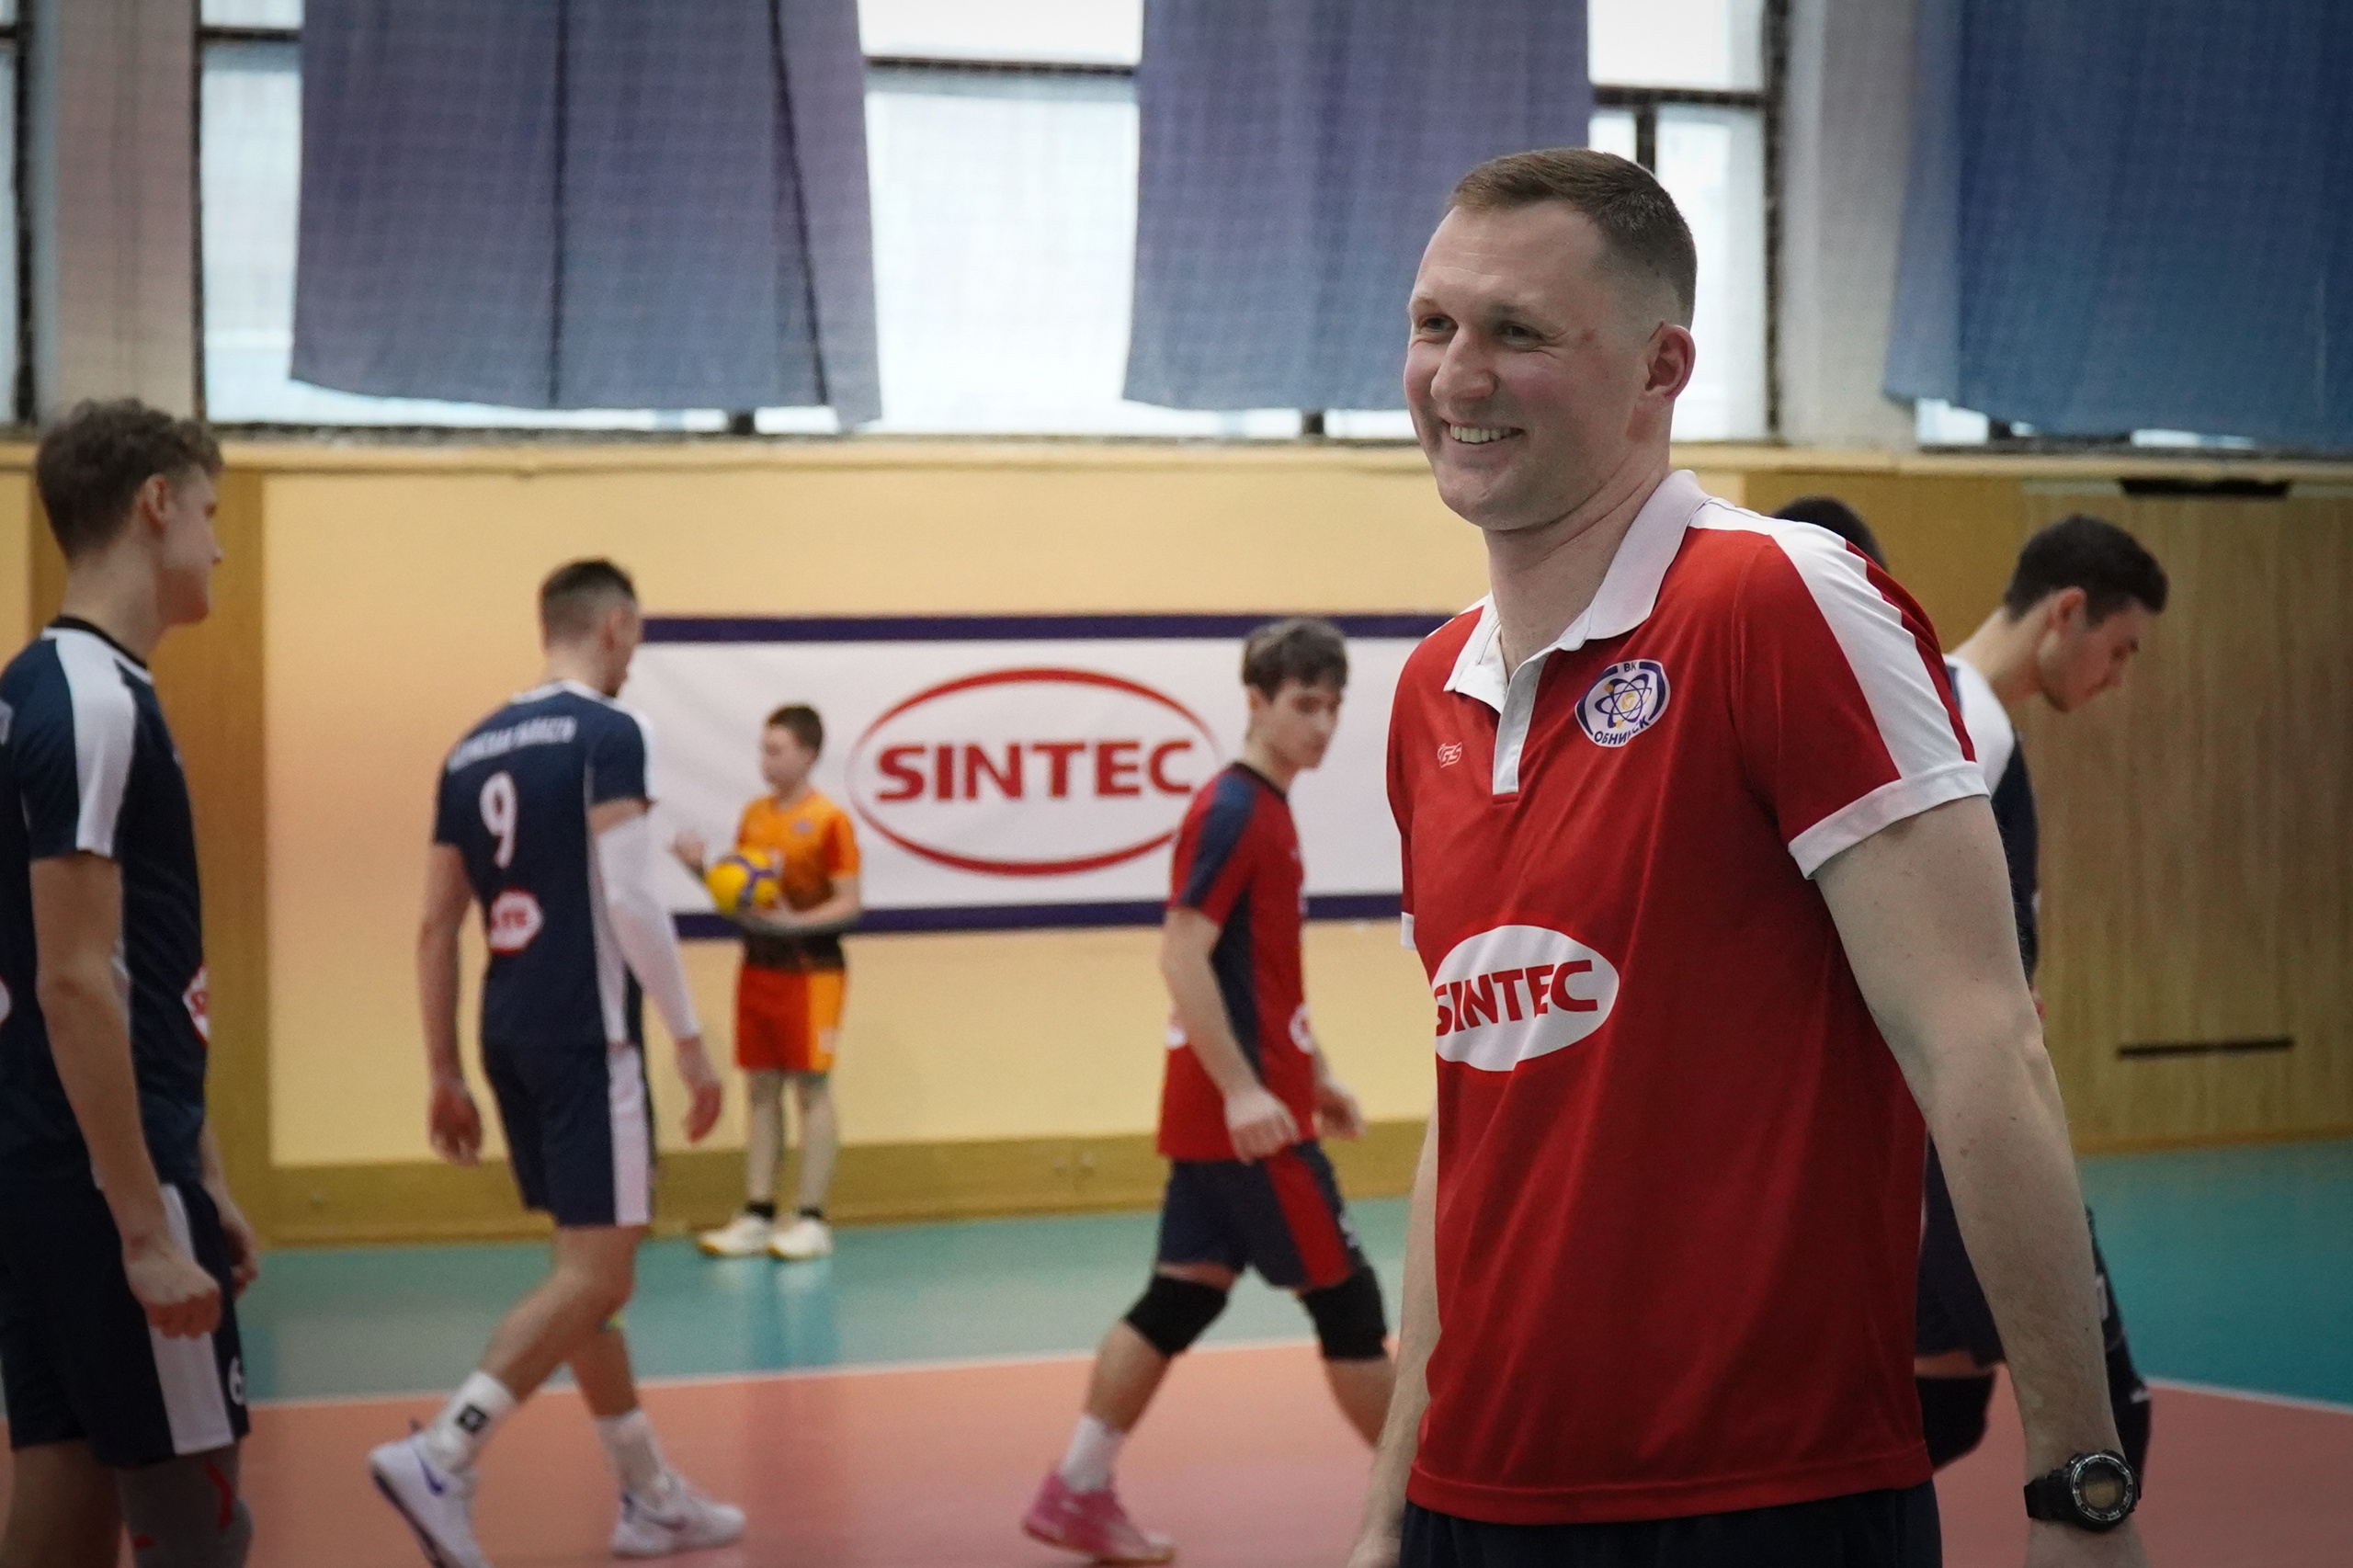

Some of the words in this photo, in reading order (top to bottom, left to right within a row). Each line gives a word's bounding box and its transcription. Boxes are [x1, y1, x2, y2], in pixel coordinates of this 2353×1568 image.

[1623, 662, 1638, 673] ВК
[876, 738, 1192, 802] SINTEC
[478, 769, 519, 870] 9
[1434, 959, 1598, 1038] SINTEC
